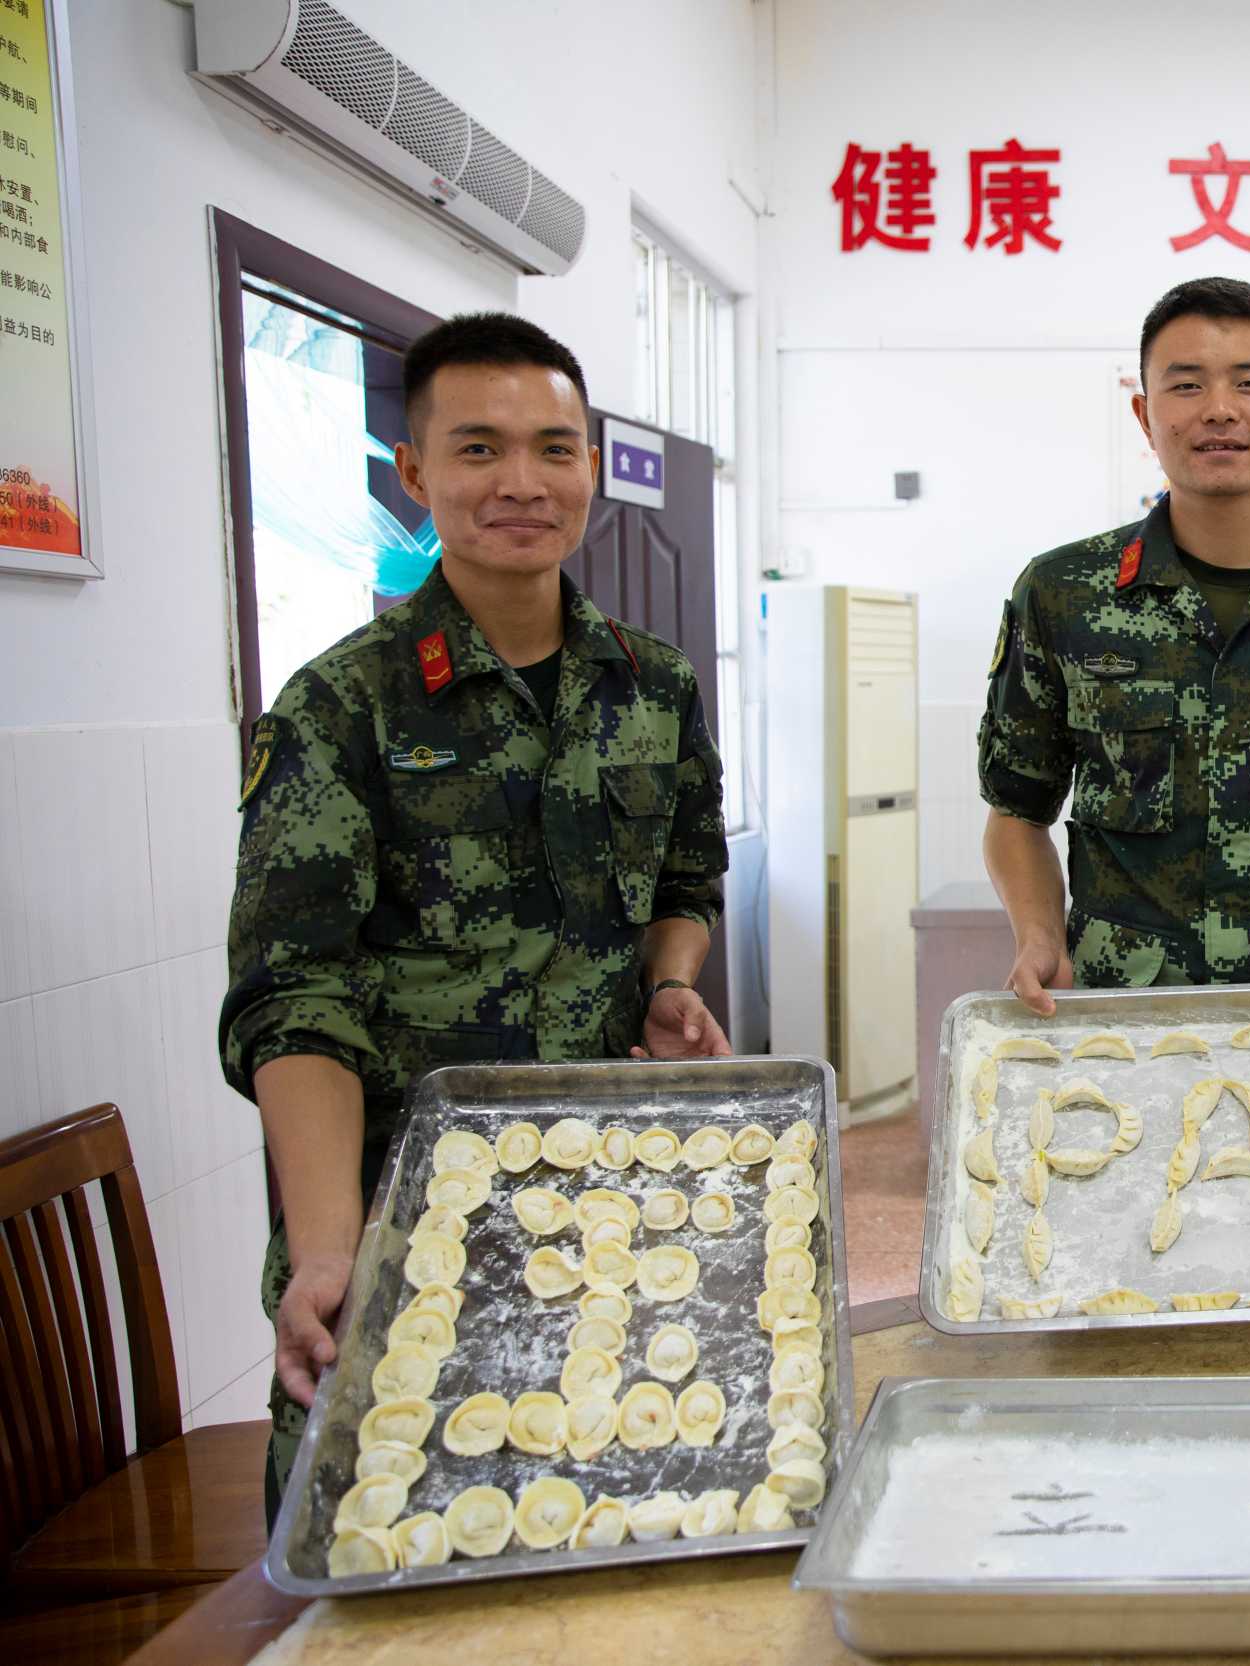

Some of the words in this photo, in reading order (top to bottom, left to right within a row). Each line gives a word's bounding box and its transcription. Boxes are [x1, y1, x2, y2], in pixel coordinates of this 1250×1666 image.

[0, 130, 36, 159] 慰问、
[831, 137, 1062, 256] 健康
[0, 270, 52, 300] 能影响公
[0, 315, 55, 346] 益为目的
[0, 468, 31, 486] 6360
